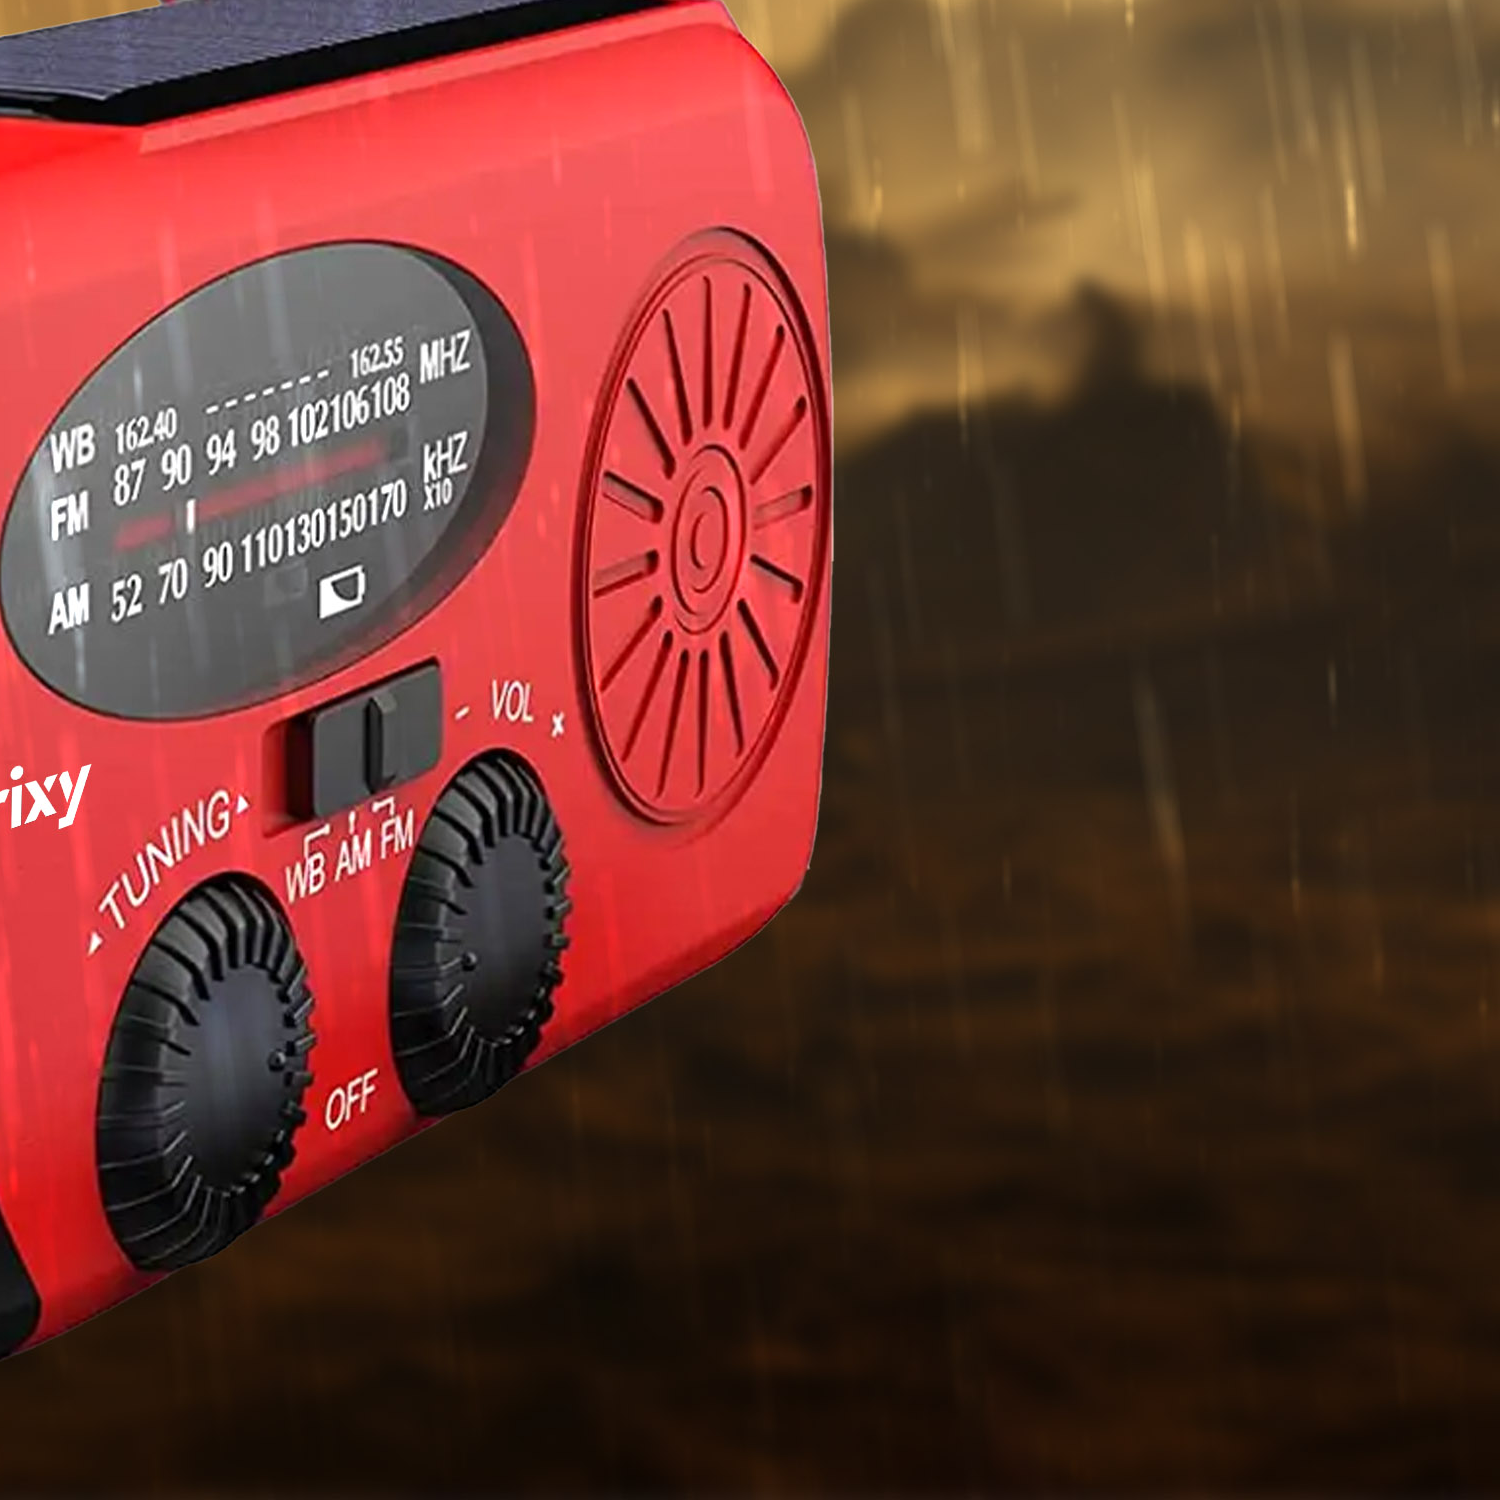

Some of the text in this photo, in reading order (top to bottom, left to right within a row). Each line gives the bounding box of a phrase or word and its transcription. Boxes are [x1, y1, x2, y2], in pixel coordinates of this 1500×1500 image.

[50, 328, 472, 474] WB 162.40 162.55 MHZ
[51, 490, 89, 542] FM
[114, 458, 147, 507] 87
[161, 443, 192, 491] 90
[206, 428, 237, 476] 94
[251, 414, 280, 462] 98
[48, 582, 90, 636] AM
[111, 573, 143, 623] 52
[158, 557, 188, 605] 70
[203, 541, 234, 589] 90
[492, 679, 534, 722] VOL
[98, 789, 230, 930] TUNING
[285, 808, 414, 904] WB AM FM
[325, 1069, 379, 1131] OFF
